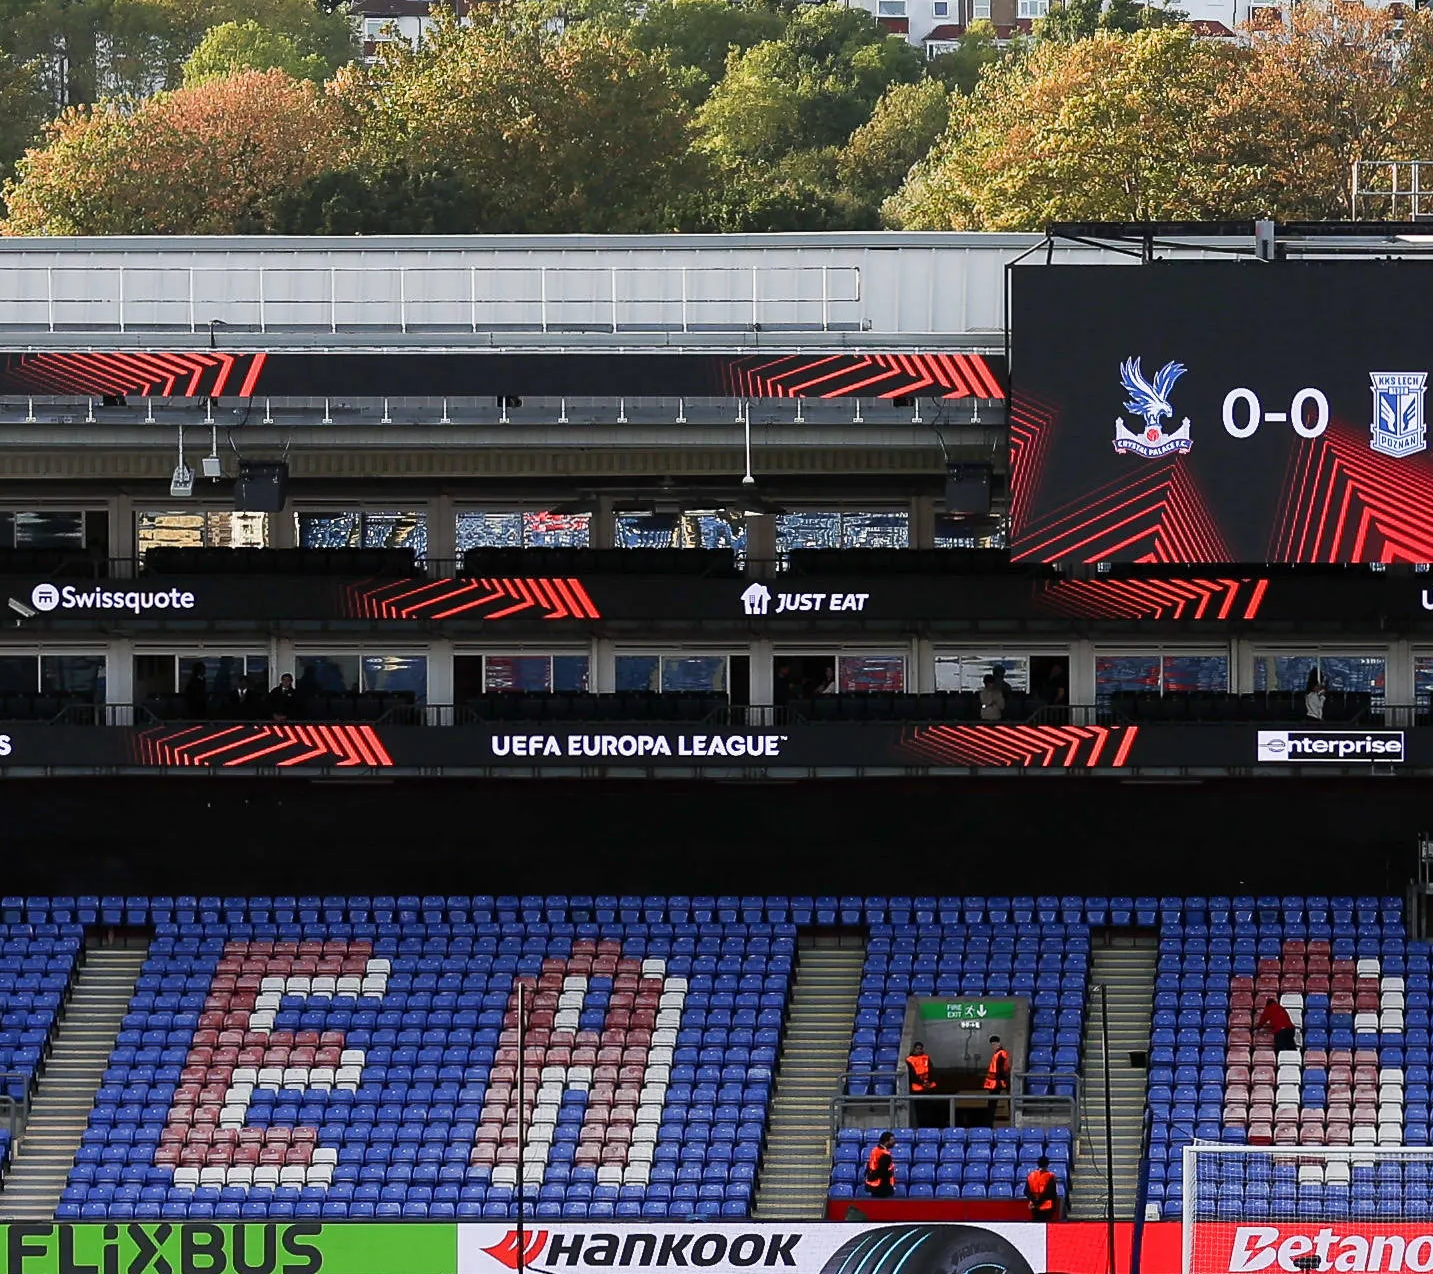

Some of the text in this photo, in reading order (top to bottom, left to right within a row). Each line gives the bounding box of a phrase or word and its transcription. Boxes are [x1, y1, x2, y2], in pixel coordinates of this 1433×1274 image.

[1397, 376, 1419, 386] LECH
[1117, 440, 1148, 456] CRYSTAL
[1148, 442, 1175, 456] PALACE
[61, 585, 195, 615] Swissquote
[775, 593, 870, 614] JUST EAT
[491, 734, 562, 757] UEFA
[567, 734, 672, 757] EUROPA
[1268, 736, 1402, 757] enterprise
